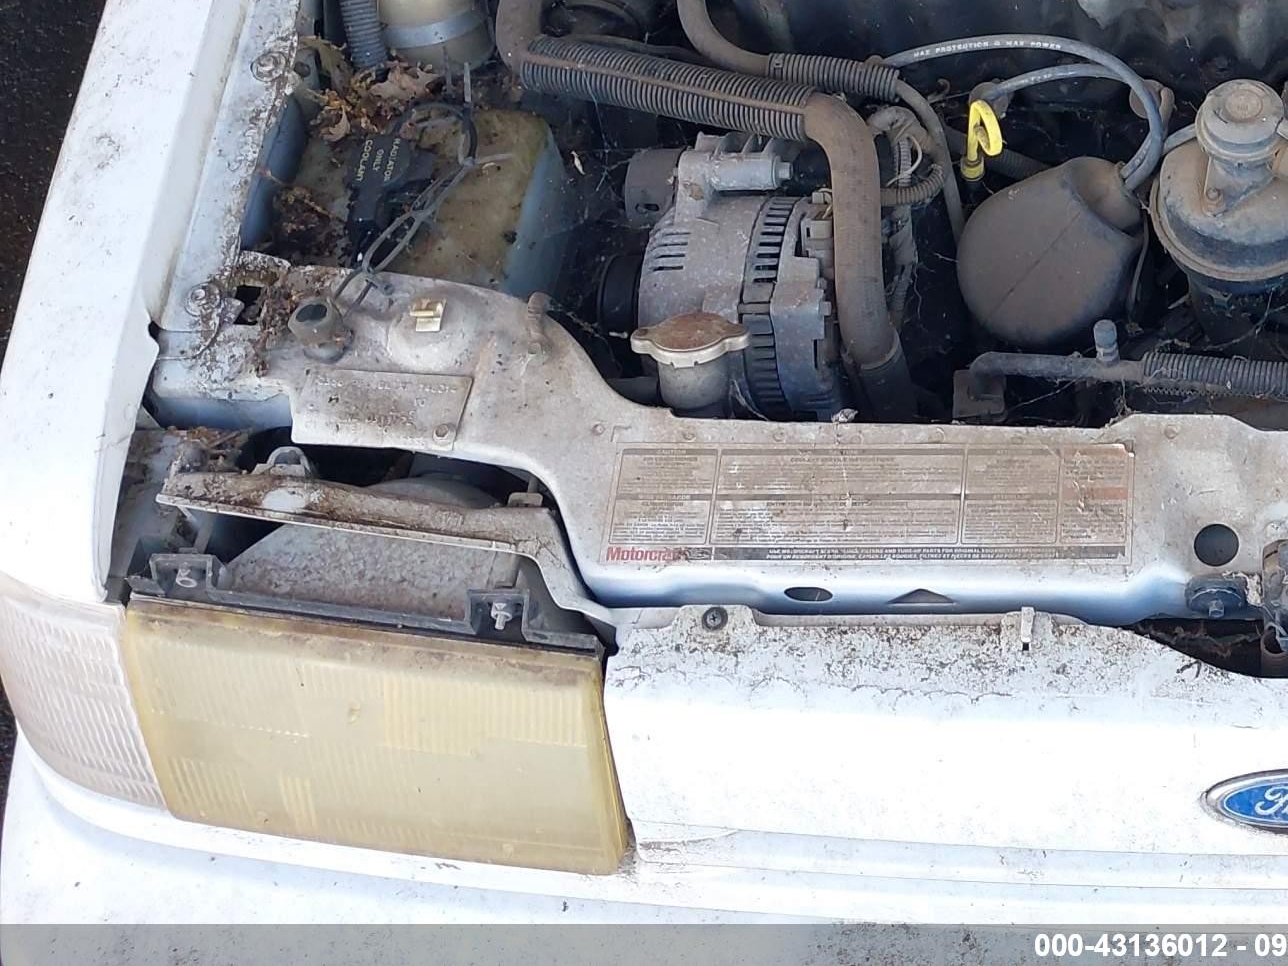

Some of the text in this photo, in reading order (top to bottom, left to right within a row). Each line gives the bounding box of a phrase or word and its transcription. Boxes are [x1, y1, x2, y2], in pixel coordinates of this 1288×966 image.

[355, 139, 374, 182] COOLANT
[372, 148, 385, 172] ONLY
[383, 137, 401, 182] RADIATOR
[606, 546, 689, 561] Motorcra
